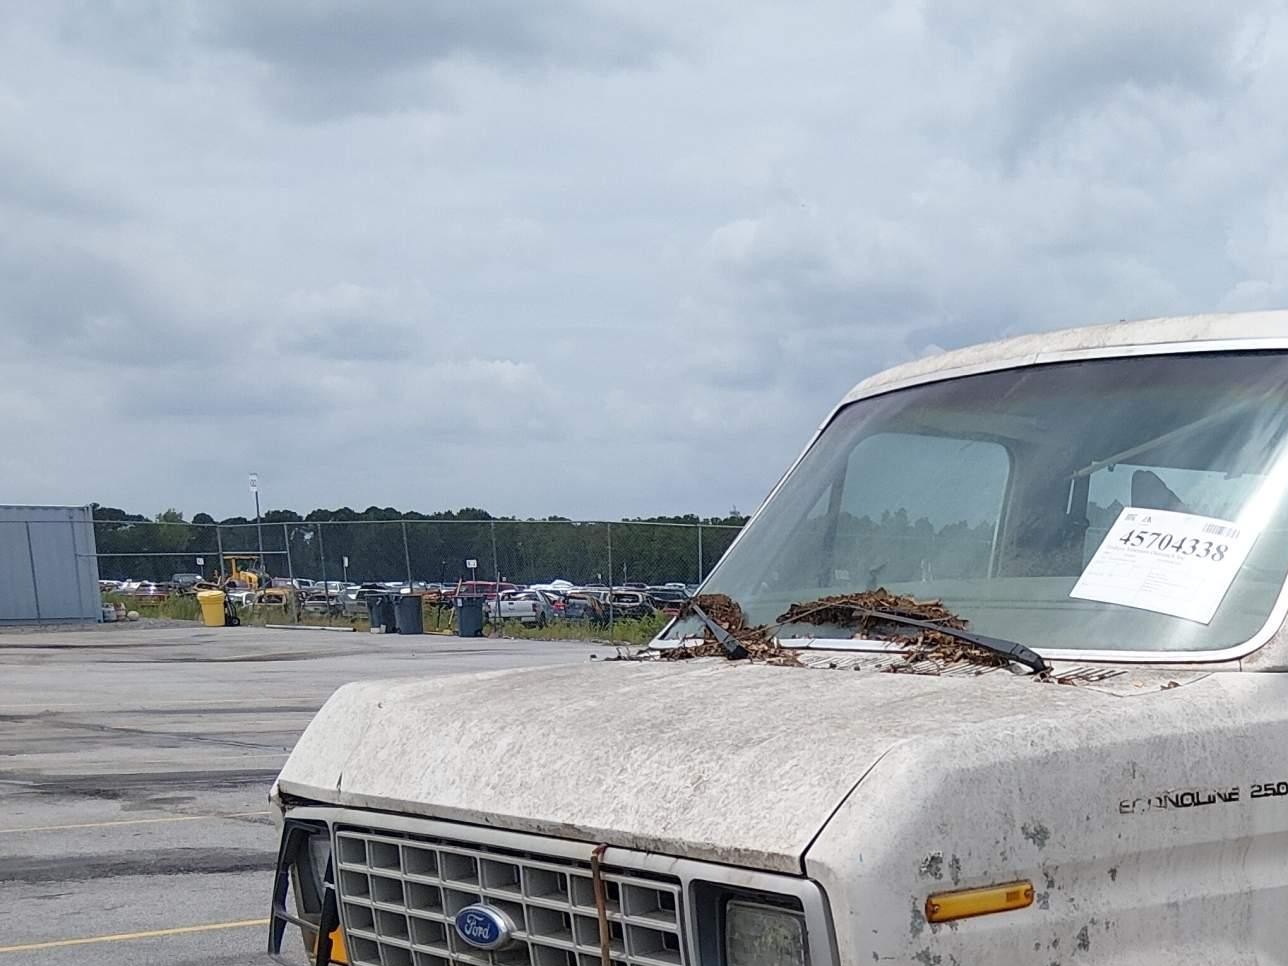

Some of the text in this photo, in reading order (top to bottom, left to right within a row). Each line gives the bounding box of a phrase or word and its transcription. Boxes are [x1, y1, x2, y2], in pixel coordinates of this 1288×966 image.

[1120, 529, 1228, 561] 45704338
[1250, 781, 1288, 799] 250
[464, 914, 491, 939] Ford
